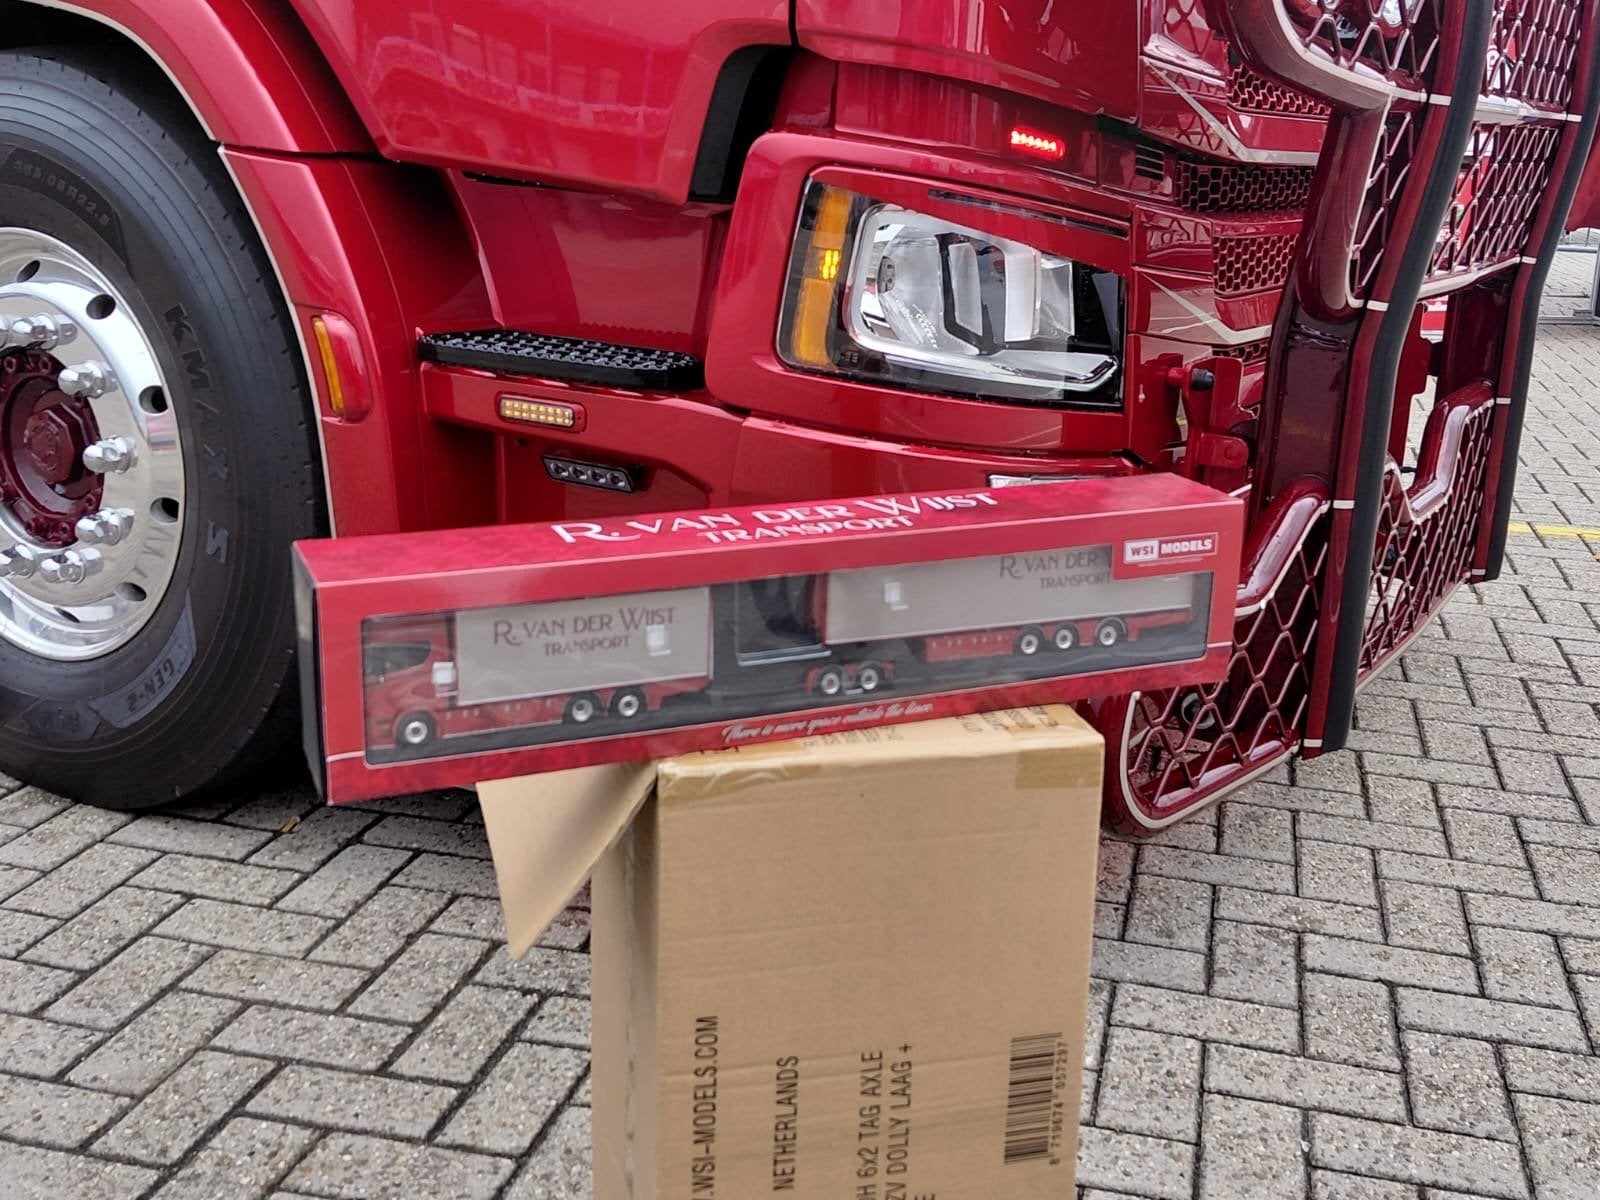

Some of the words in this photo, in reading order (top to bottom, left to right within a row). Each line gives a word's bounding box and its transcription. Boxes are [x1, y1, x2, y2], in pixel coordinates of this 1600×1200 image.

[630, 513, 738, 534] VAN
[754, 503, 853, 526] DER
[697, 514, 914, 544] TRANSPORT
[1024, 554, 1059, 573] VAN
[1065, 550, 1099, 570] DER
[1130, 545, 1155, 557] WSI
[1160, 538, 1213, 555] MODELS
[1040, 571, 1112, 590] TRANSPORT
[522, 618, 566, 640] VAN
[573, 613, 613, 635] DER
[544, 634, 633, 657] TRANSPORT
[860, 1049, 883, 1098] AXLE
[889, 1060, 913, 1109] LAAG
[691, 1015, 719, 1200] .WSI-MODELS.COM
[772, 1054, 799, 1192] NETHERLANDS
[858, 1104, 882, 1142] TAG
[886, 1117, 911, 1174] DOLLY
[856, 1146, 880, 1179] 6x2
